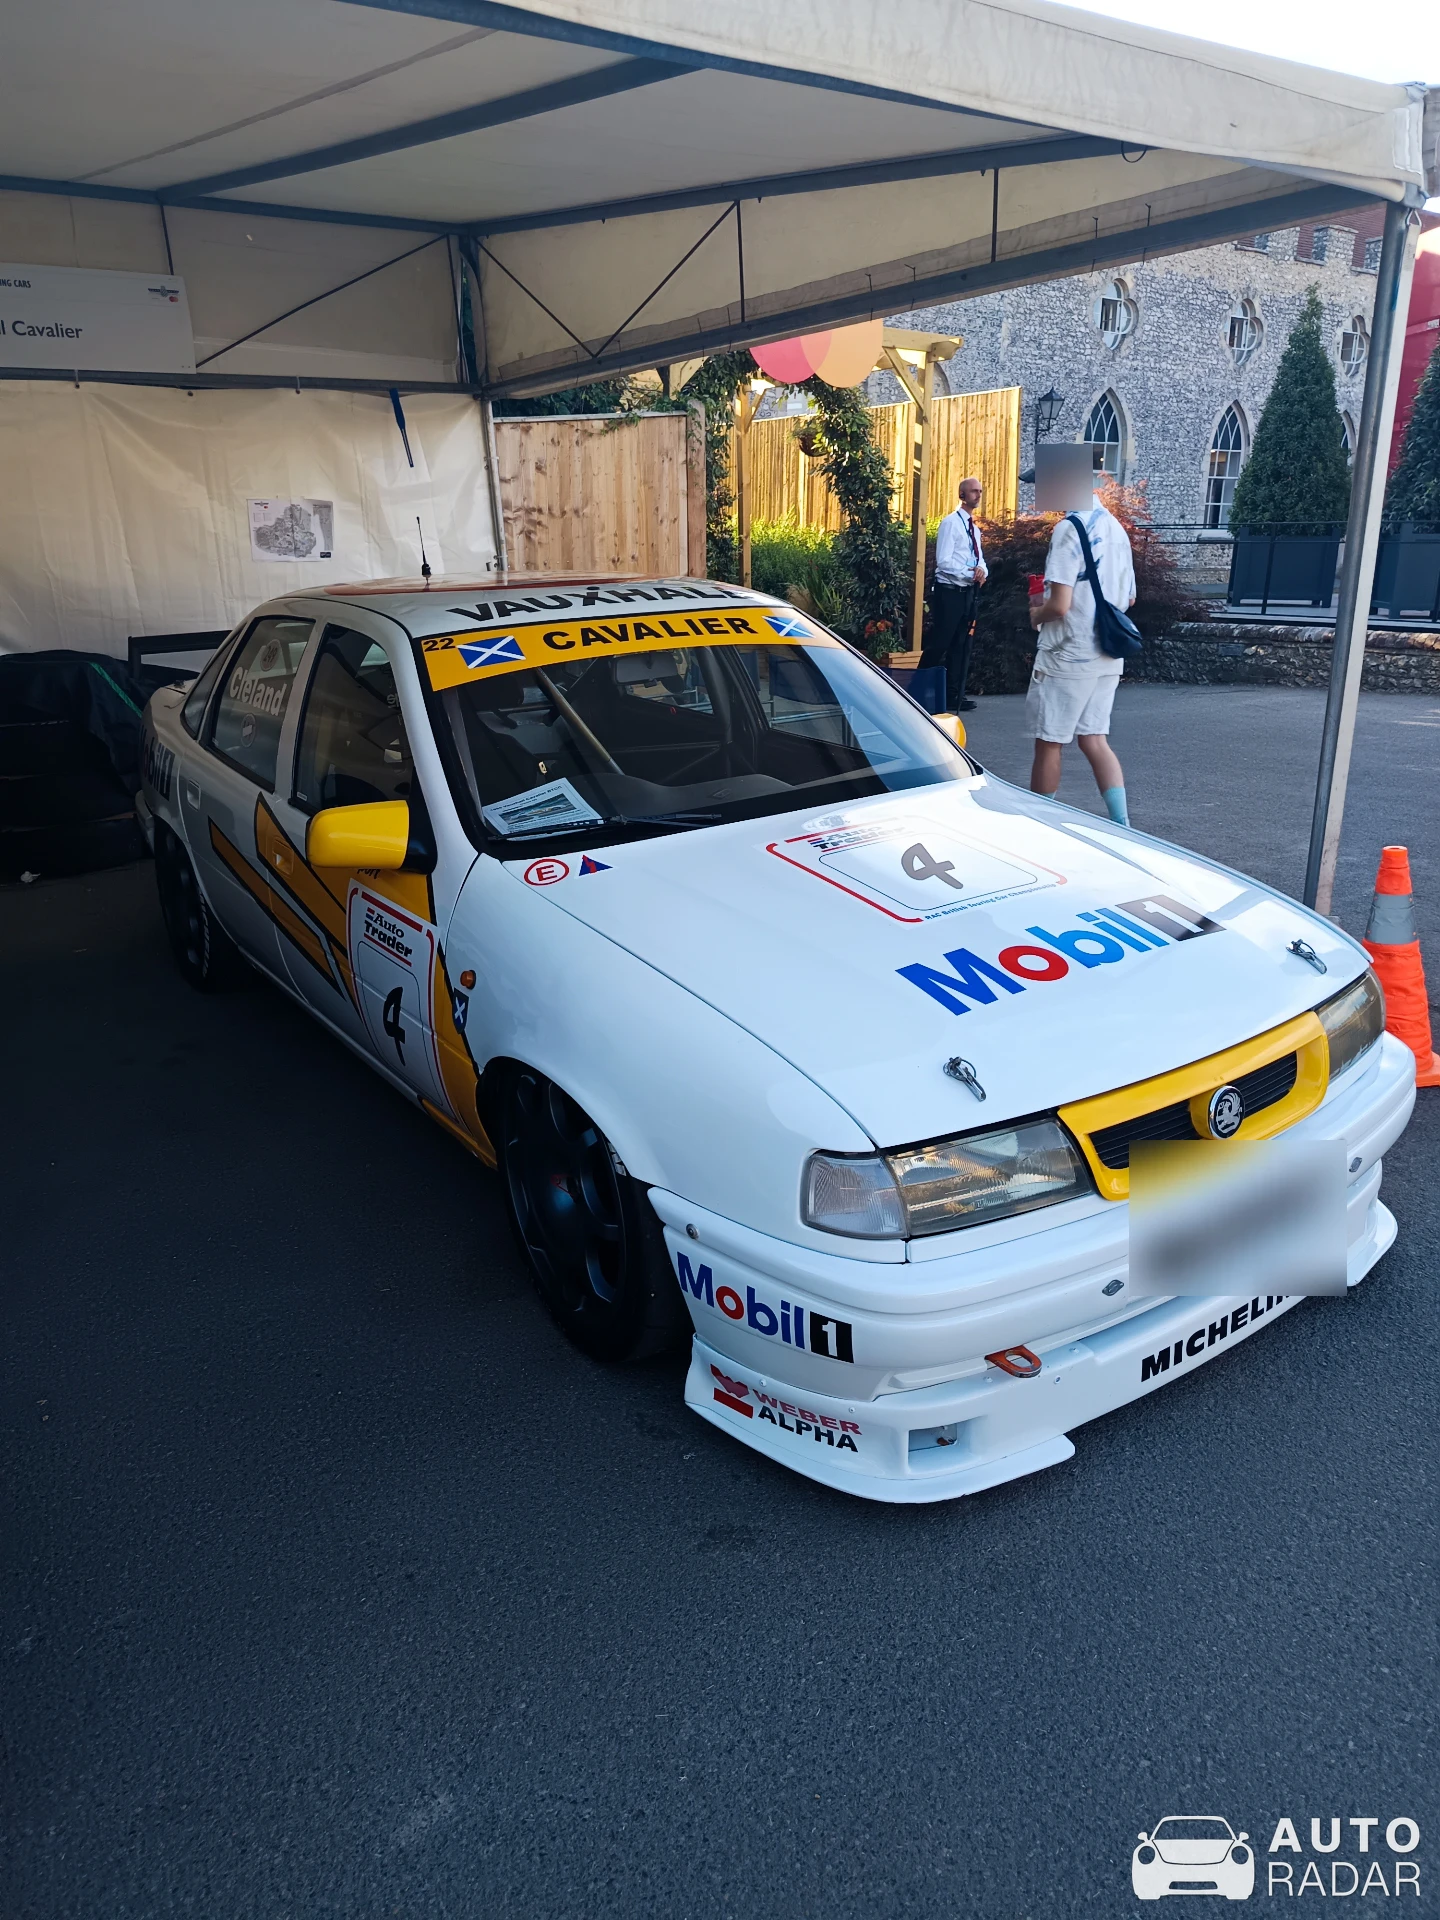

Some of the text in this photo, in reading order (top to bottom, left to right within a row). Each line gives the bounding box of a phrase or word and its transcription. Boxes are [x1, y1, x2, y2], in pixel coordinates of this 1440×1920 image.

[13, 279, 32, 288] CARS
[12, 320, 83, 338] Cavalier
[422, 617, 759, 652] 22 CAVALIER
[229, 666, 288, 717] Cleland
[536, 864, 557, 882] E
[901, 842, 964, 890] 4
[364, 919, 413, 957] Trader
[372, 912, 405, 938] Auto
[383, 986, 406, 1067] 4
[1141, 1296, 1290, 1382] MICHELI
[752, 1388, 862, 1435] WEBER
[758, 1406, 859, 1453] ALPHA
